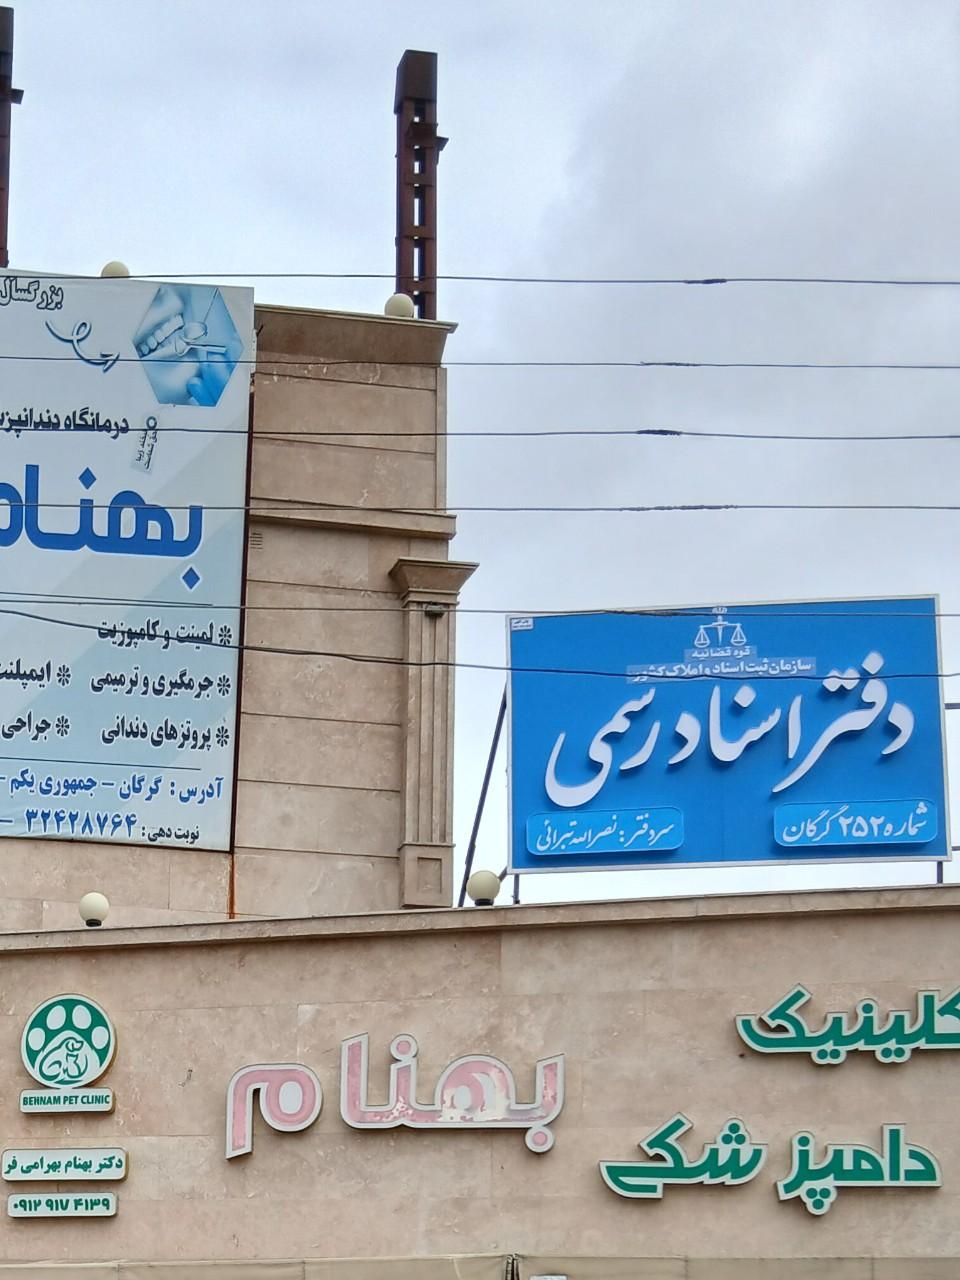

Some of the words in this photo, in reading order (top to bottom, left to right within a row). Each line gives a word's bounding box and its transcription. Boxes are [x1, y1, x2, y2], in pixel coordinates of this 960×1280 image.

[64, 407, 130, 439] درمانگاه
[98, 619, 159, 648] کامپوزیت
[161, 631, 171, 649] و
[176, 622, 214, 649] لمینت
[671, 663, 704, 677] املاک
[711, 660, 744, 674] اسناد
[745, 657, 769, 672] ثبت
[769, 658, 812, 674] سازمان
[90, 666, 139, 695] ترمیمی
[142, 678, 150, 696] و
[152, 668, 214, 698] جرمگیری
[1, 709, 51, 741] جراحی
[102, 714, 148, 745] دندانی
[151, 719, 212, 751] پروتزهای
[669, 684, 803, 765] اسناد
[772, 651, 915, 793] دفتر
[544, 686, 660, 808] رسمی
[10, 768, 35, 799] یکم
[39, 772, 98, 799] جمهوری
[119, 773, 162, 800] گرگان
[25, 807, 138, 838] ۳۲۴۲۸۷۶۴
[782, 804, 849, 842] گرگان
[884, 802, 928, 837] شماره
[174, 824, 200, 845] نوبت
[22, 1095, 61, 1107] BEHNAM
[63, 1095, 80, 1106] PET
[80, 1094, 110, 1105] CLINIC
[225, 1032, 565, 1160] بهنام
[64, 1156, 92, 1174] بهنام
[96, 1155, 123, 1174] دکتر
[44, 1197, 69, 1211] ۹۱۷
